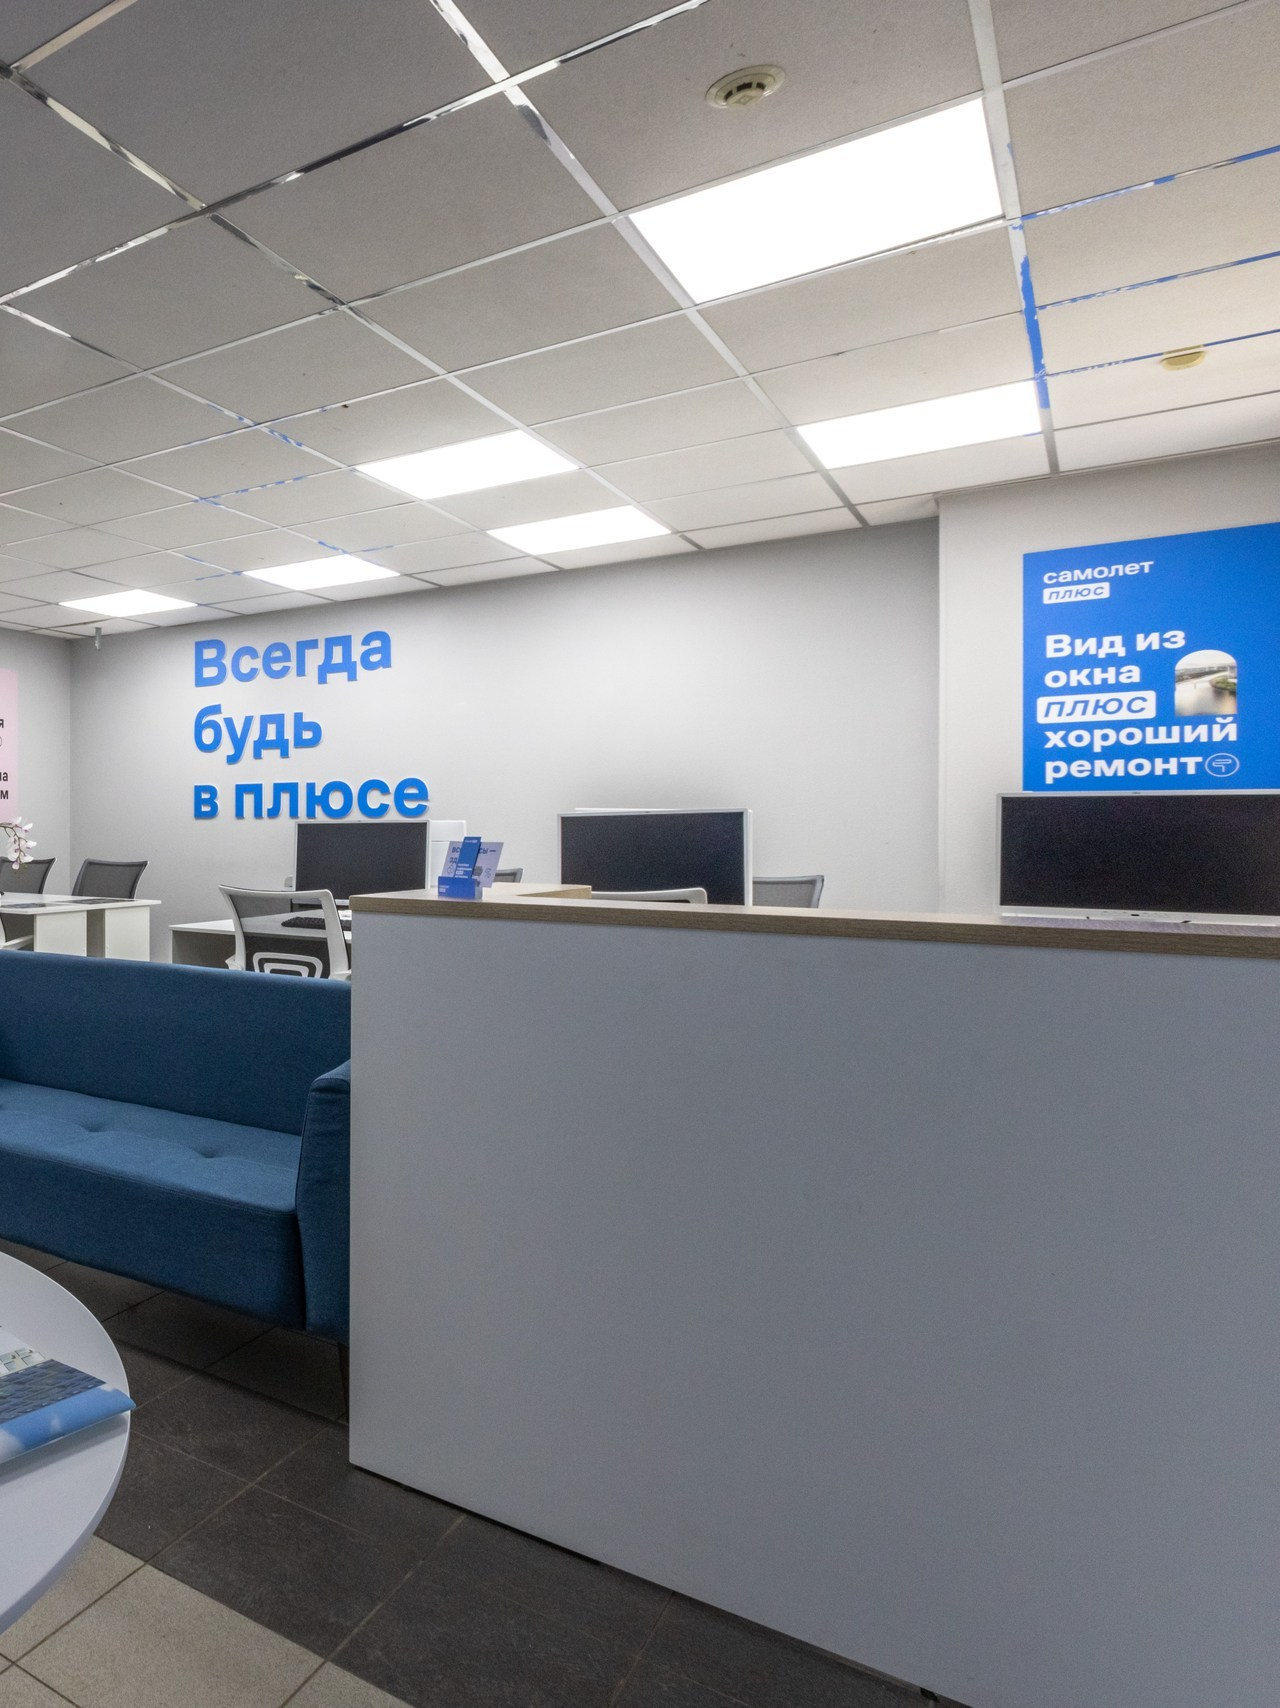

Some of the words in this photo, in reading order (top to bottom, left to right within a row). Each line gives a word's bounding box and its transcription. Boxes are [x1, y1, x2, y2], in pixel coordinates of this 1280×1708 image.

[1043, 561, 1154, 584] самолет
[1048, 586, 1105, 601] плюс
[1045, 634, 1126, 658] Вид
[1136, 630, 1186, 651] из
[194, 631, 392, 688] Всегда
[1044, 665, 1141, 688] окна
[1043, 696, 1149, 718] плюс
[194, 704, 323, 765] будь
[1043, 717, 1237, 752] хороший
[1045, 757, 1203, 784] ремонт
[194, 784, 219, 819] в
[235, 777, 430, 820] плюсе
